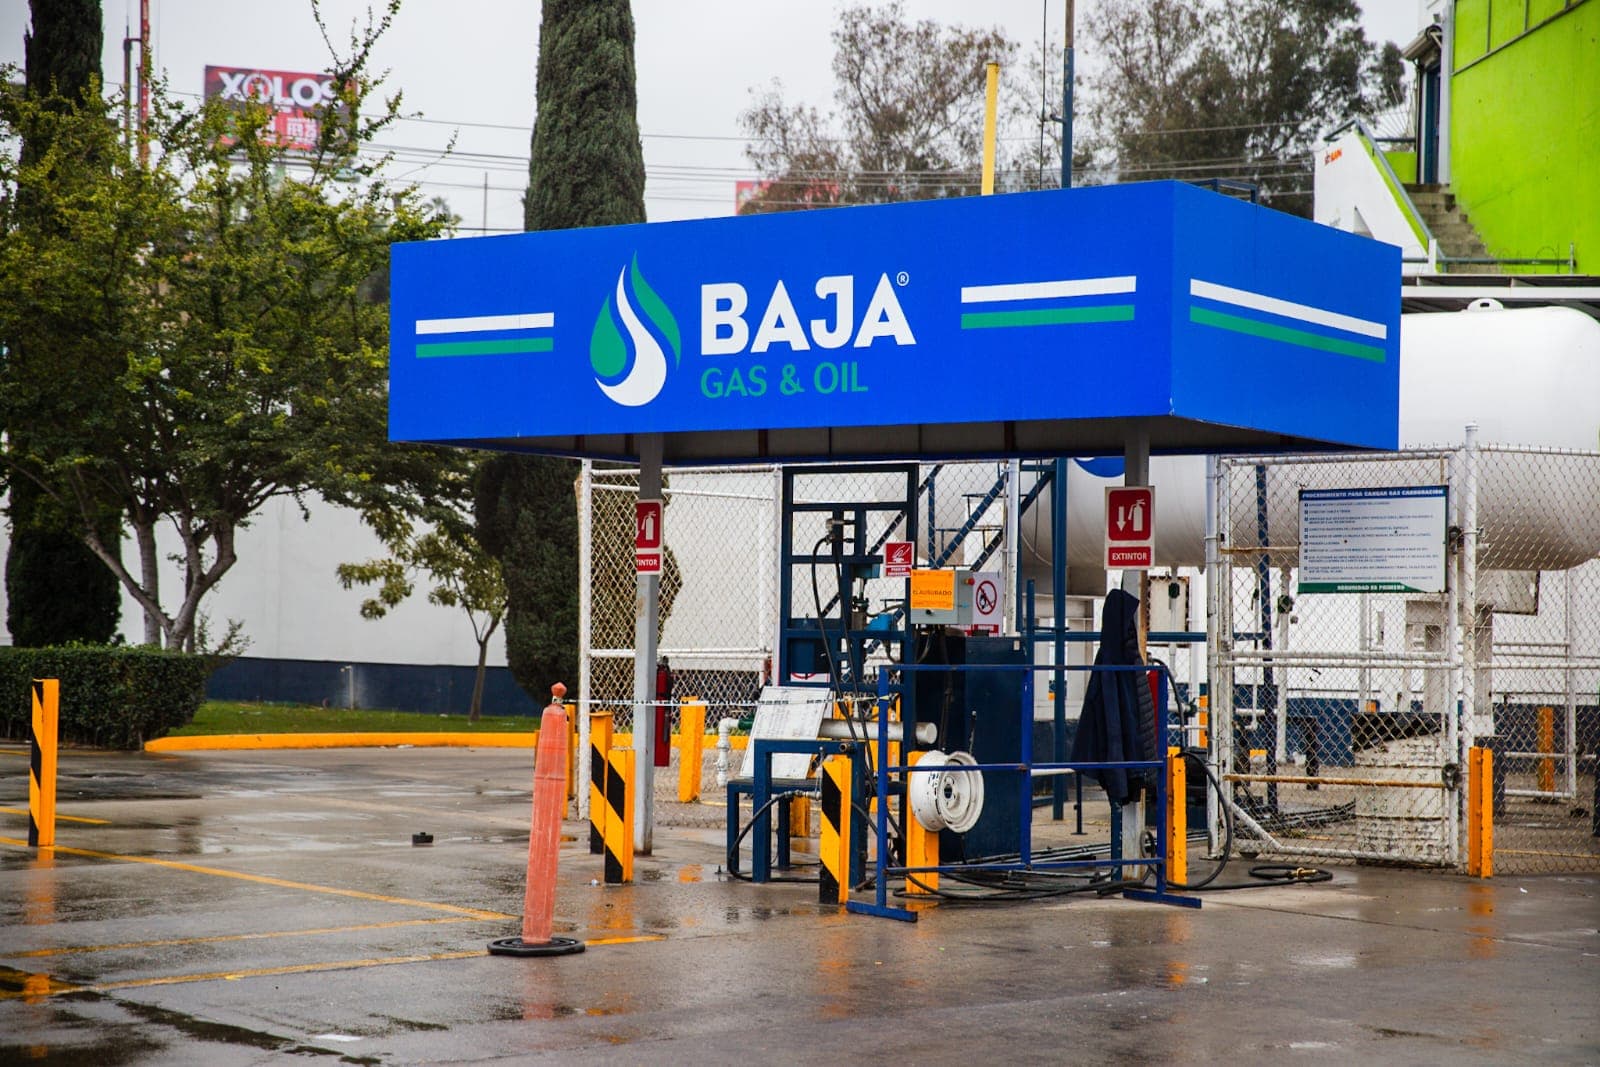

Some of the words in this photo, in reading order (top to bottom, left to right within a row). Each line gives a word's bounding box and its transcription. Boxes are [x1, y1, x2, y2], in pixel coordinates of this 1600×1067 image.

[701, 365, 767, 398] GAS
[779, 364, 804, 396] &
[814, 361, 868, 394] OIL
[1112, 552, 1147, 560] EXTINTOR
